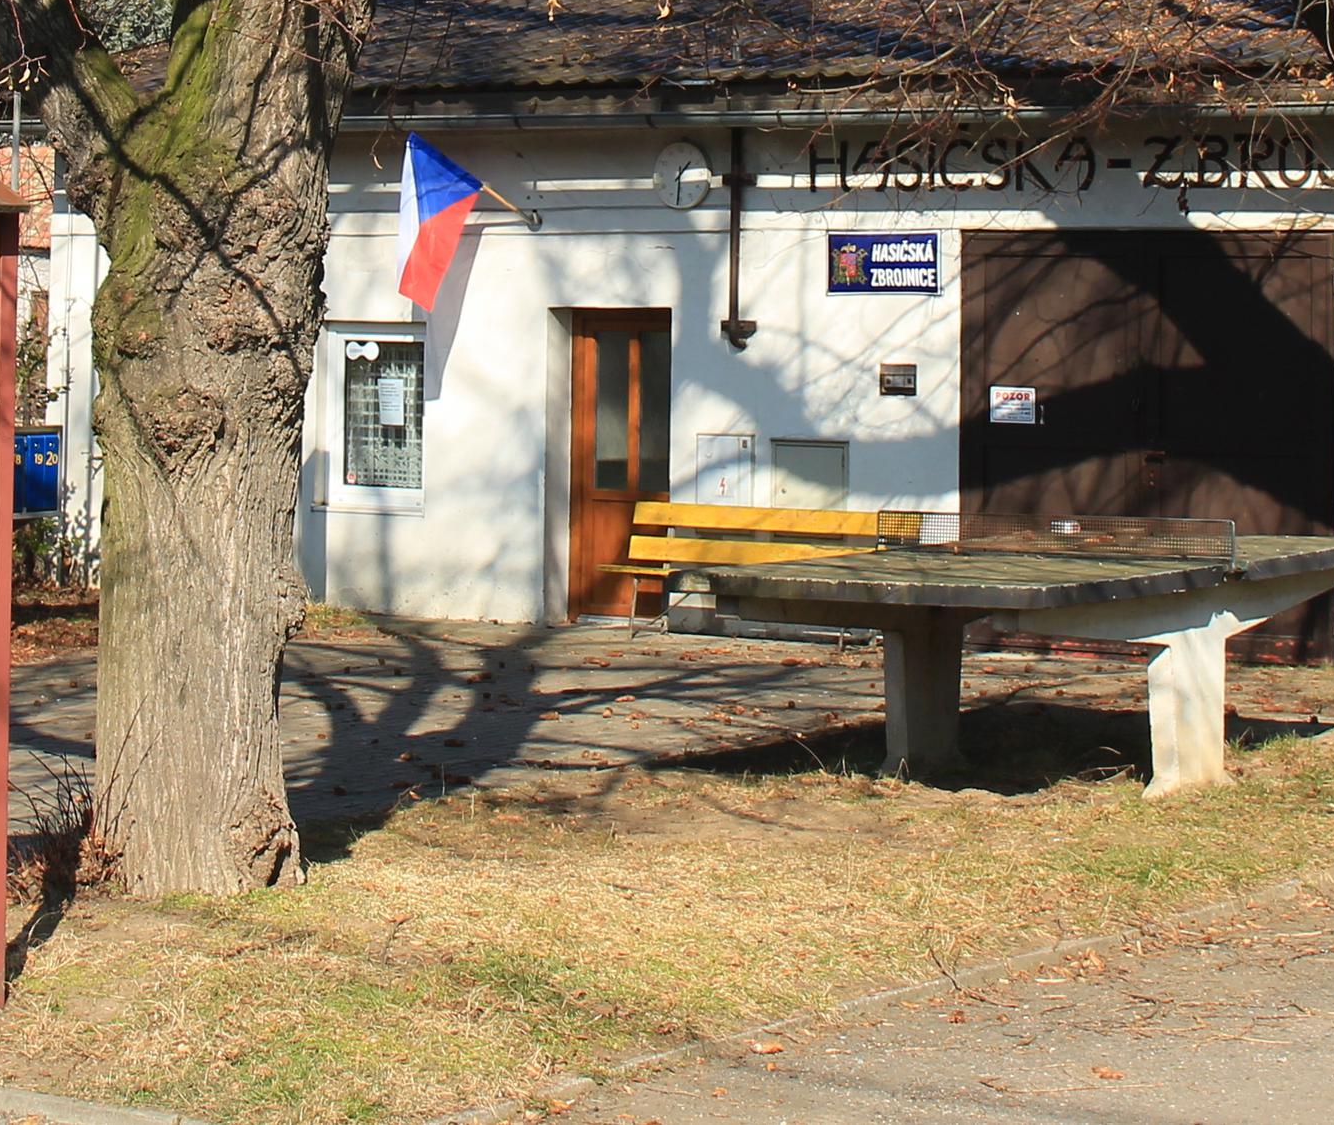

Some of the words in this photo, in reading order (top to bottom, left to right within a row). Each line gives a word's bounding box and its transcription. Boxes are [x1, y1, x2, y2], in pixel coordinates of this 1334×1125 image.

[871, 239, 935, 263] HASIČSKÁ
[870, 268, 937, 288] ZBROJNICE
[995, 391, 1031, 401] POZOR
[34, 453, 44, 465] 19
[45, 451, 59, 466] 20
